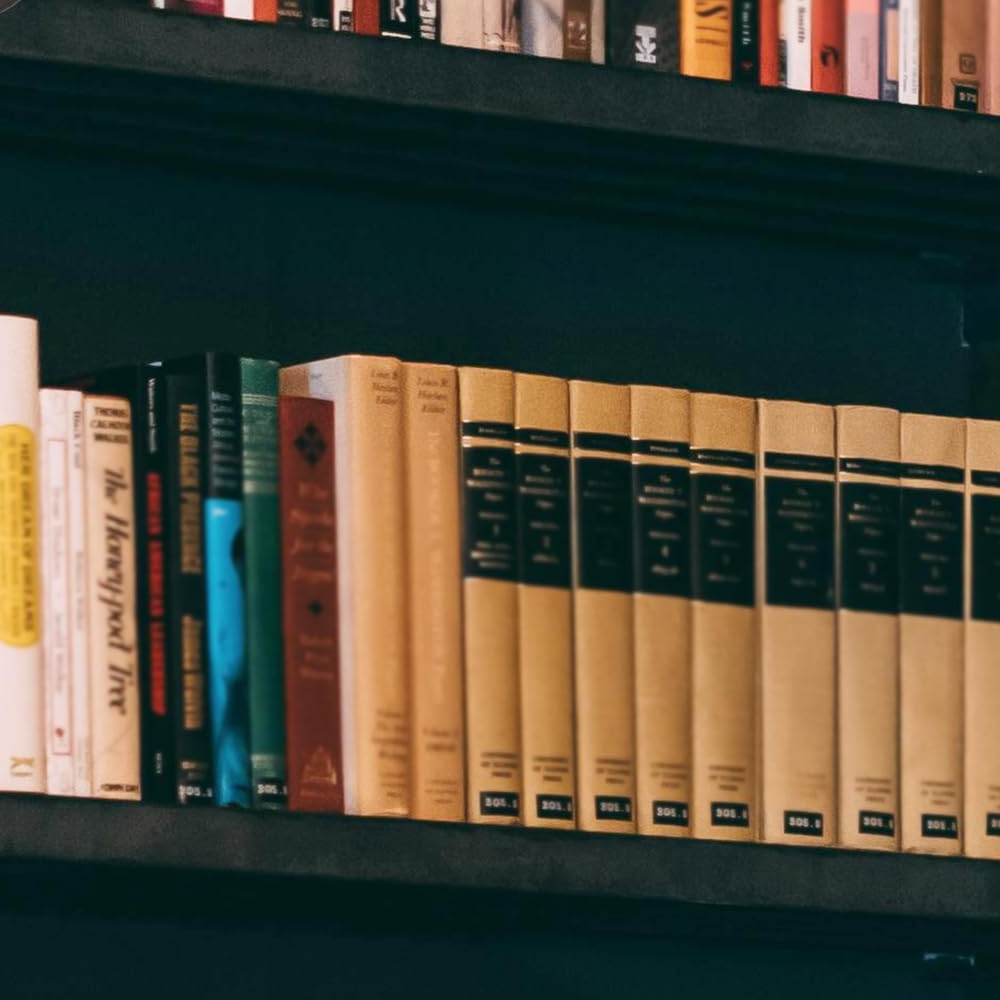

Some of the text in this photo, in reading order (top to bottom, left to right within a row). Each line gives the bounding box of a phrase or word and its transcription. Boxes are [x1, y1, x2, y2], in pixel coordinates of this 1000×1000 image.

[742, 1, 756, 46] Smith
[796, 5, 809, 44] Smith
[179, 403, 202, 488] THE BLACK
[20, 443, 36, 632] HER DREAM OF DREAMS
[97, 466, 135, 717] The Honey-pod Tree
